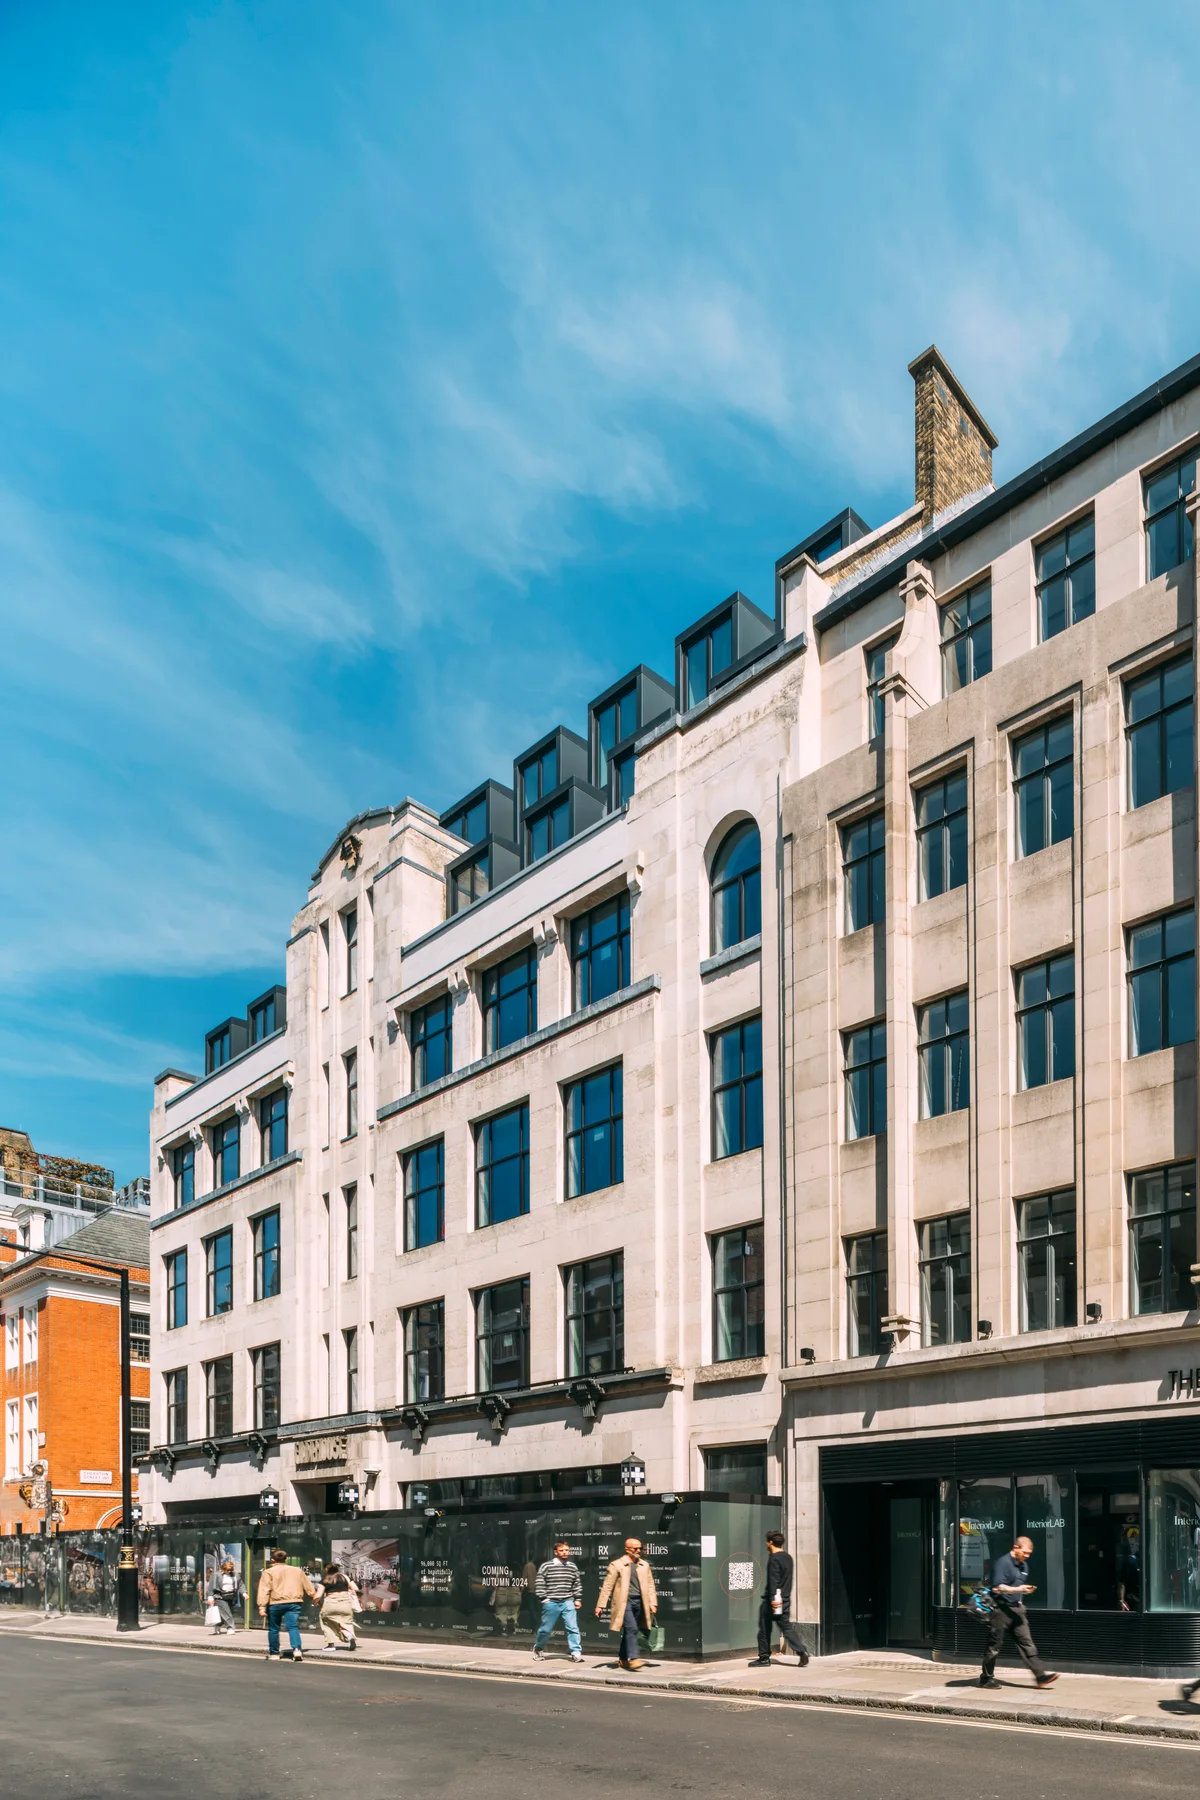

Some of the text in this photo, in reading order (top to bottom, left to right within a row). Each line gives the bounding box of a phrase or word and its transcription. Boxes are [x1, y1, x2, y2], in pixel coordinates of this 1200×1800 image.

[968, 1520, 1005, 1530] InteriorLAB
[1026, 1518, 1066, 1529] InteriorLAB
[598, 1545, 609, 1556] RX
[646, 1543, 669, 1555] Hines
[481, 1566, 509, 1575] COMING
[482, 1577, 528, 1587] AUTUMN 2024
